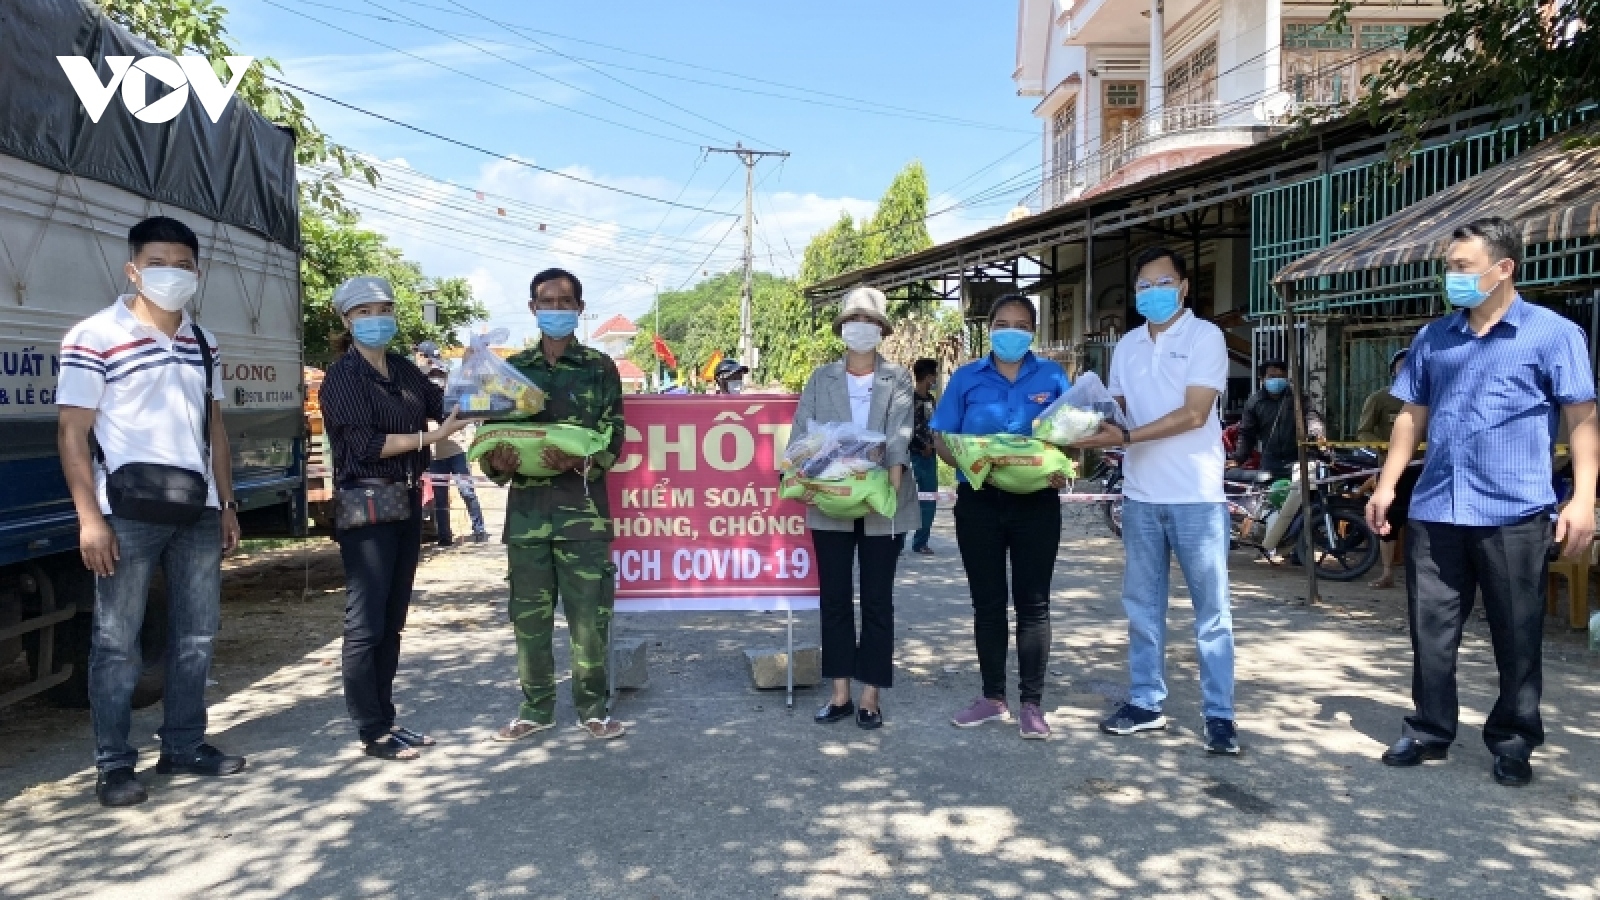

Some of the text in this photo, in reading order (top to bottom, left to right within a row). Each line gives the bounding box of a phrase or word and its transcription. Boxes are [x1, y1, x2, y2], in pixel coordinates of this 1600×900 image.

[0, 346, 45, 376] UẤT
[222, 364, 276, 382] LONG
[621, 477, 695, 508] KIỂM
[704, 482, 777, 508] SOÁT
[613, 507, 805, 540] HÒNG, CHỐNG
[612, 547, 810, 589] ỊCH COVID-19
